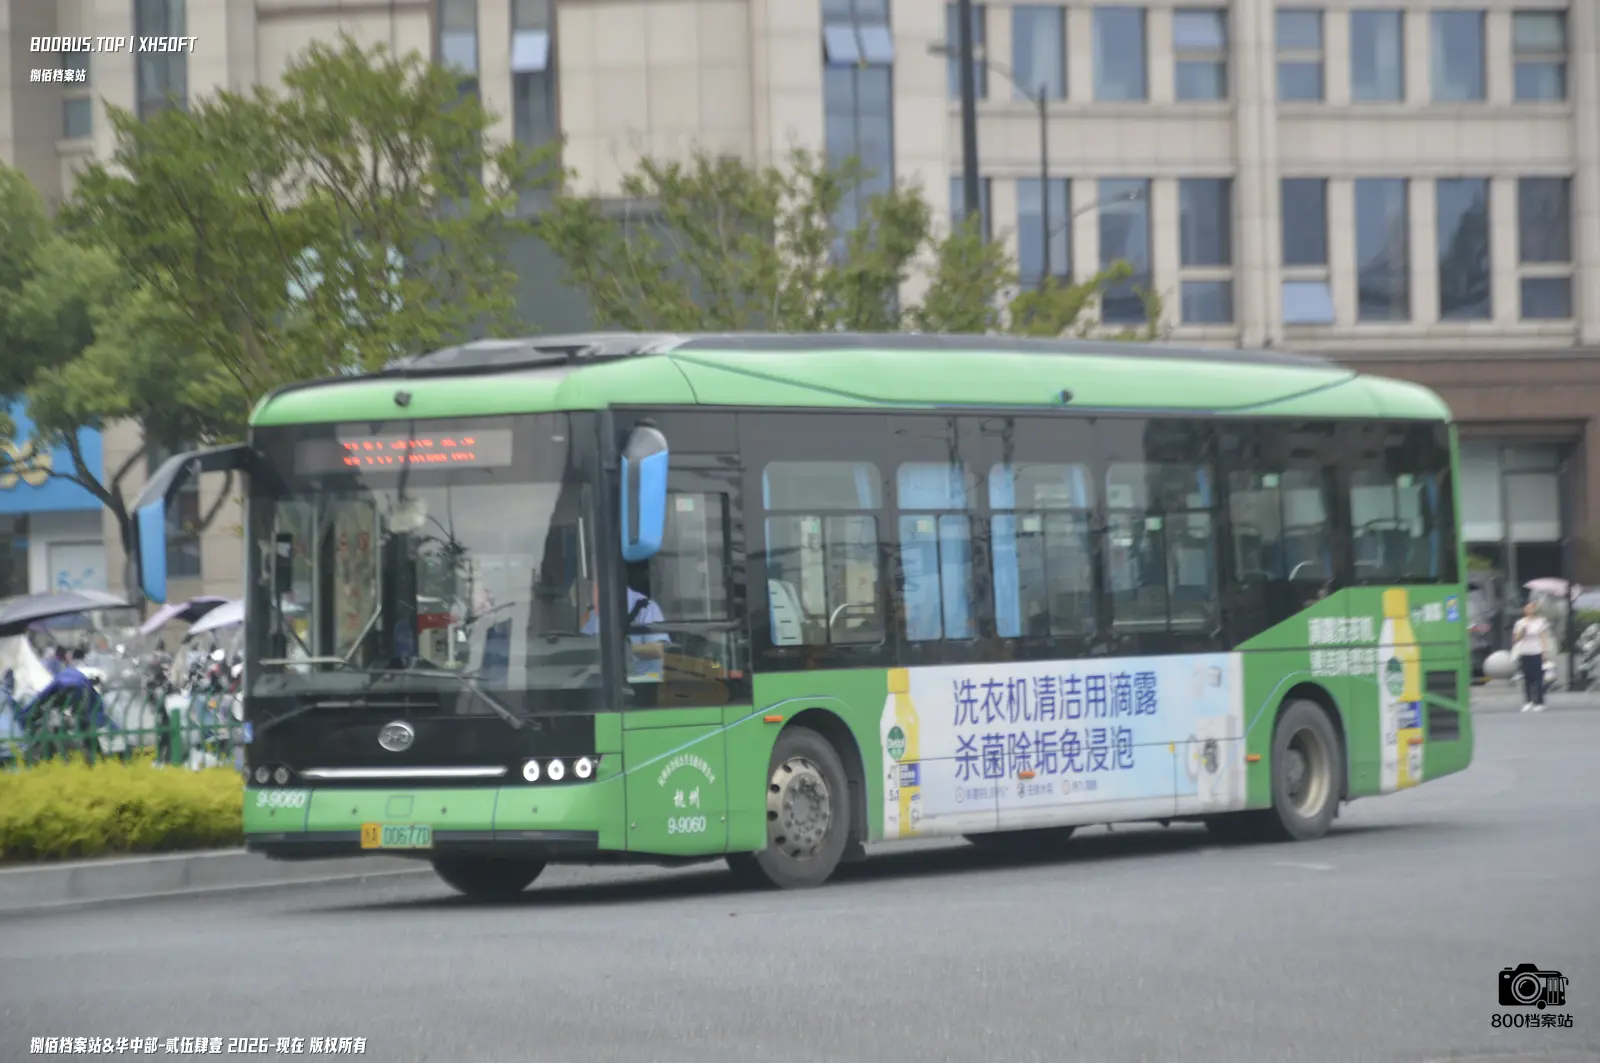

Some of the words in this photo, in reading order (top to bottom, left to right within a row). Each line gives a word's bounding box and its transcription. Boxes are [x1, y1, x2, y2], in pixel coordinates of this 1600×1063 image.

[952, 670, 1158, 727] 洗衣机清洁用滴露
[954, 724, 1135, 782] 杀菌除垢免浸泡
[256, 791, 306, 808] 9-9060
[668, 815, 707, 835] 9-9060
